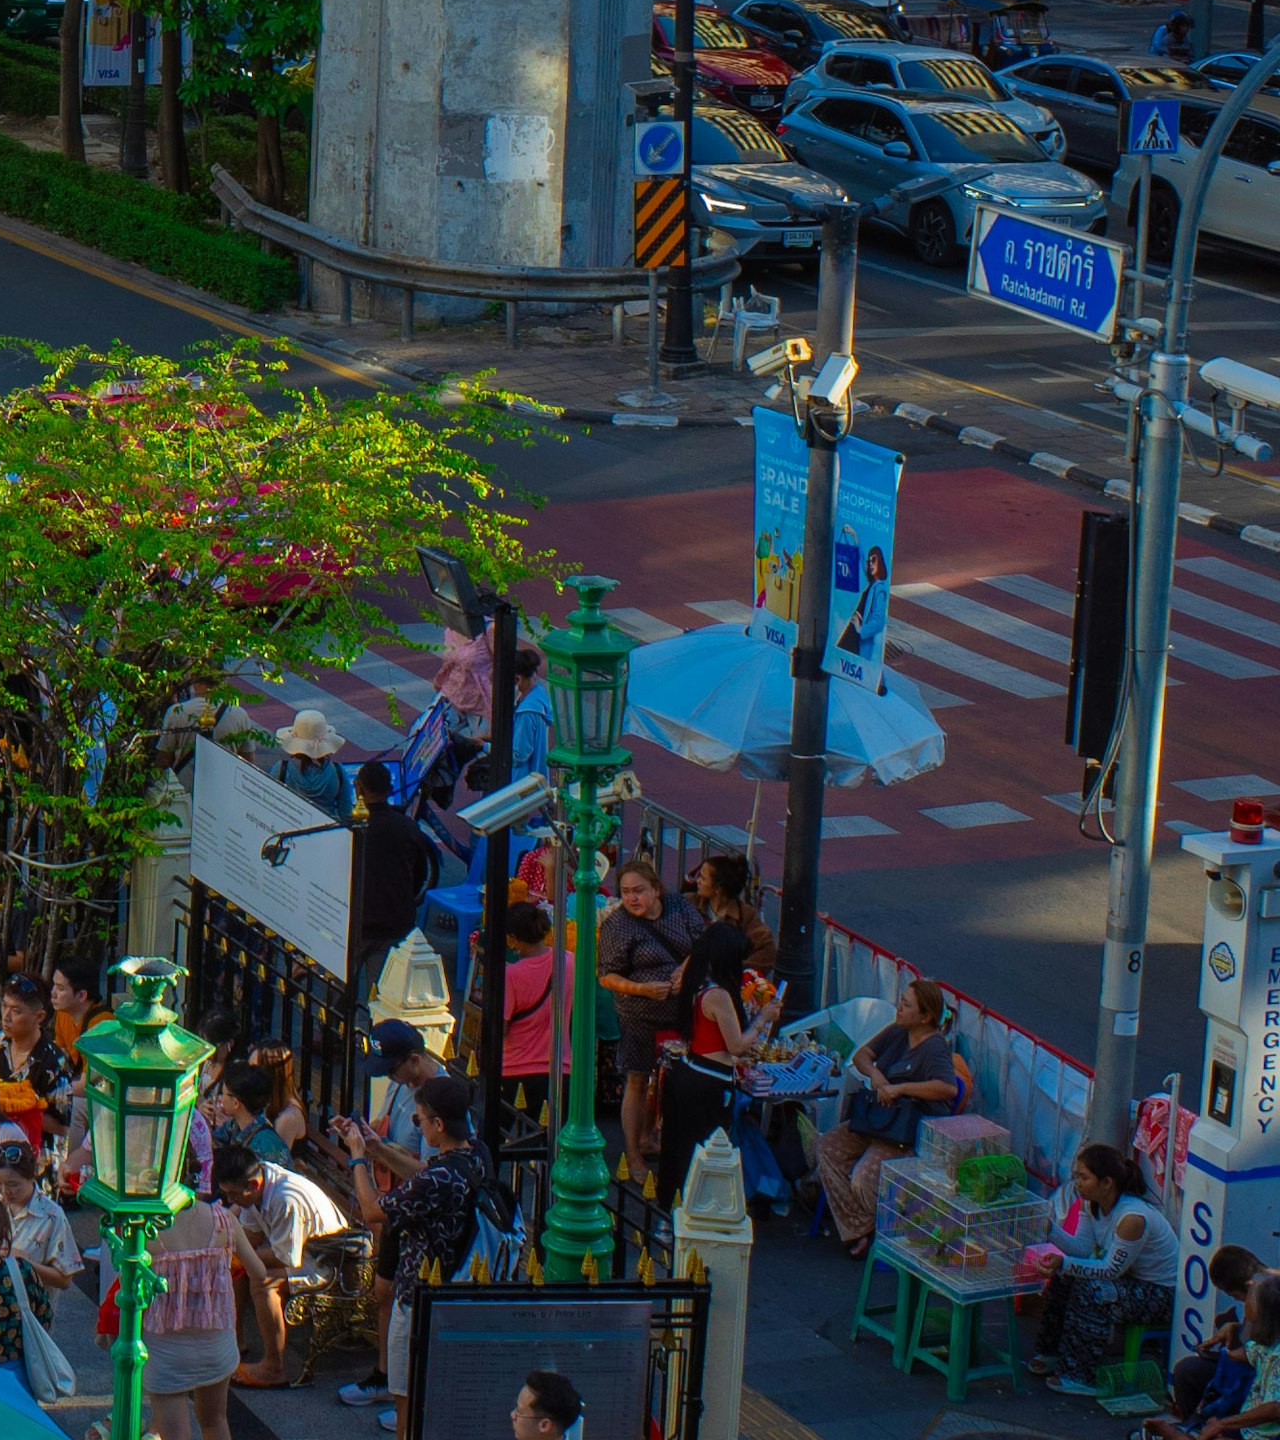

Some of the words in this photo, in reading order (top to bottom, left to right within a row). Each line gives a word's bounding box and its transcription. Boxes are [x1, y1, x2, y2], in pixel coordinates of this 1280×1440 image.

[98, 69, 120, 79] VISA
[1004, 239, 1018, 265] ถ.
[1023, 239, 1095, 290] ราชดำริ
[1001, 274, 1065, 311] Ratchadamri
[1070, 298, 1088, 320] Rd.
[763, 489, 800, 514] SALE
[765, 625, 786, 648] VISA
[841, 658, 863, 681] VISA
[1128, 951, 1141, 972] 8
[1182, 1201, 1213, 1351] SOS
